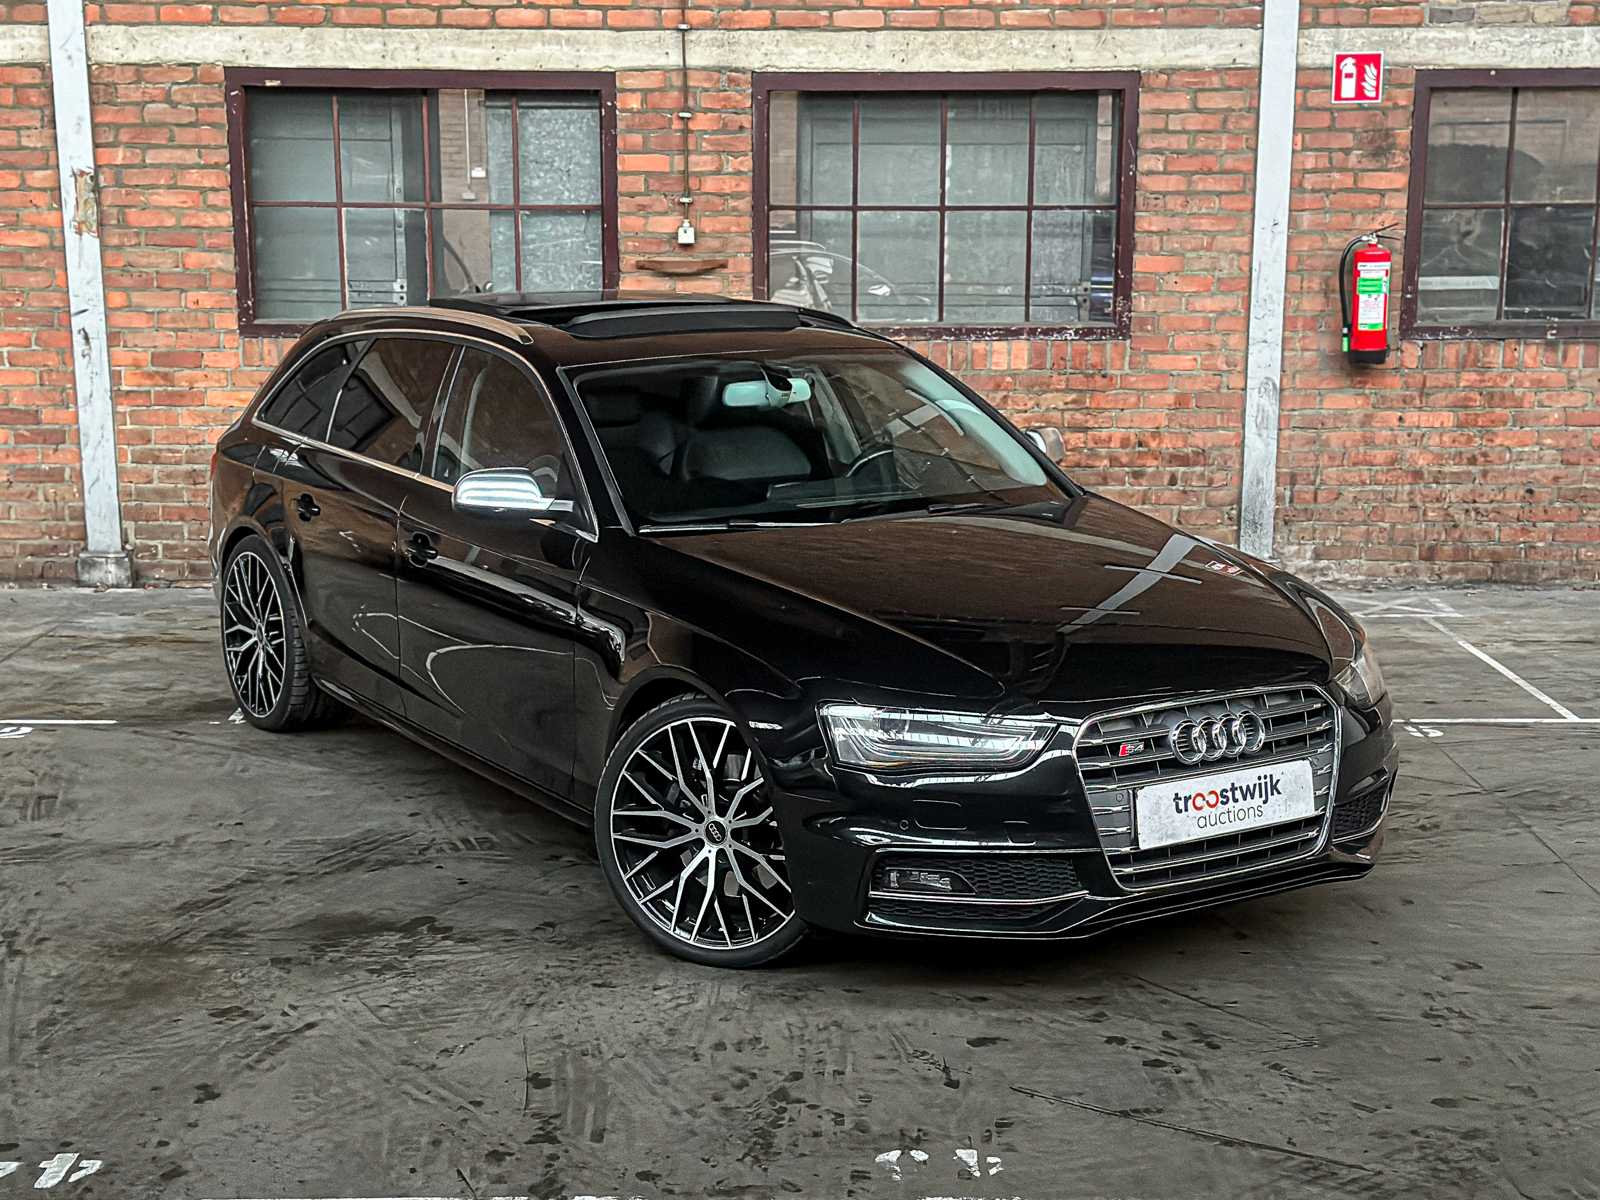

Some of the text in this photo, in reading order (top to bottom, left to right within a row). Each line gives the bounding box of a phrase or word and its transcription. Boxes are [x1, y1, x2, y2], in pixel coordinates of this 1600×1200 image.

[1121, 741, 1145, 756] S4
[1173, 774, 1282, 813] troostwijk
[1197, 804, 1264, 829] auctions
